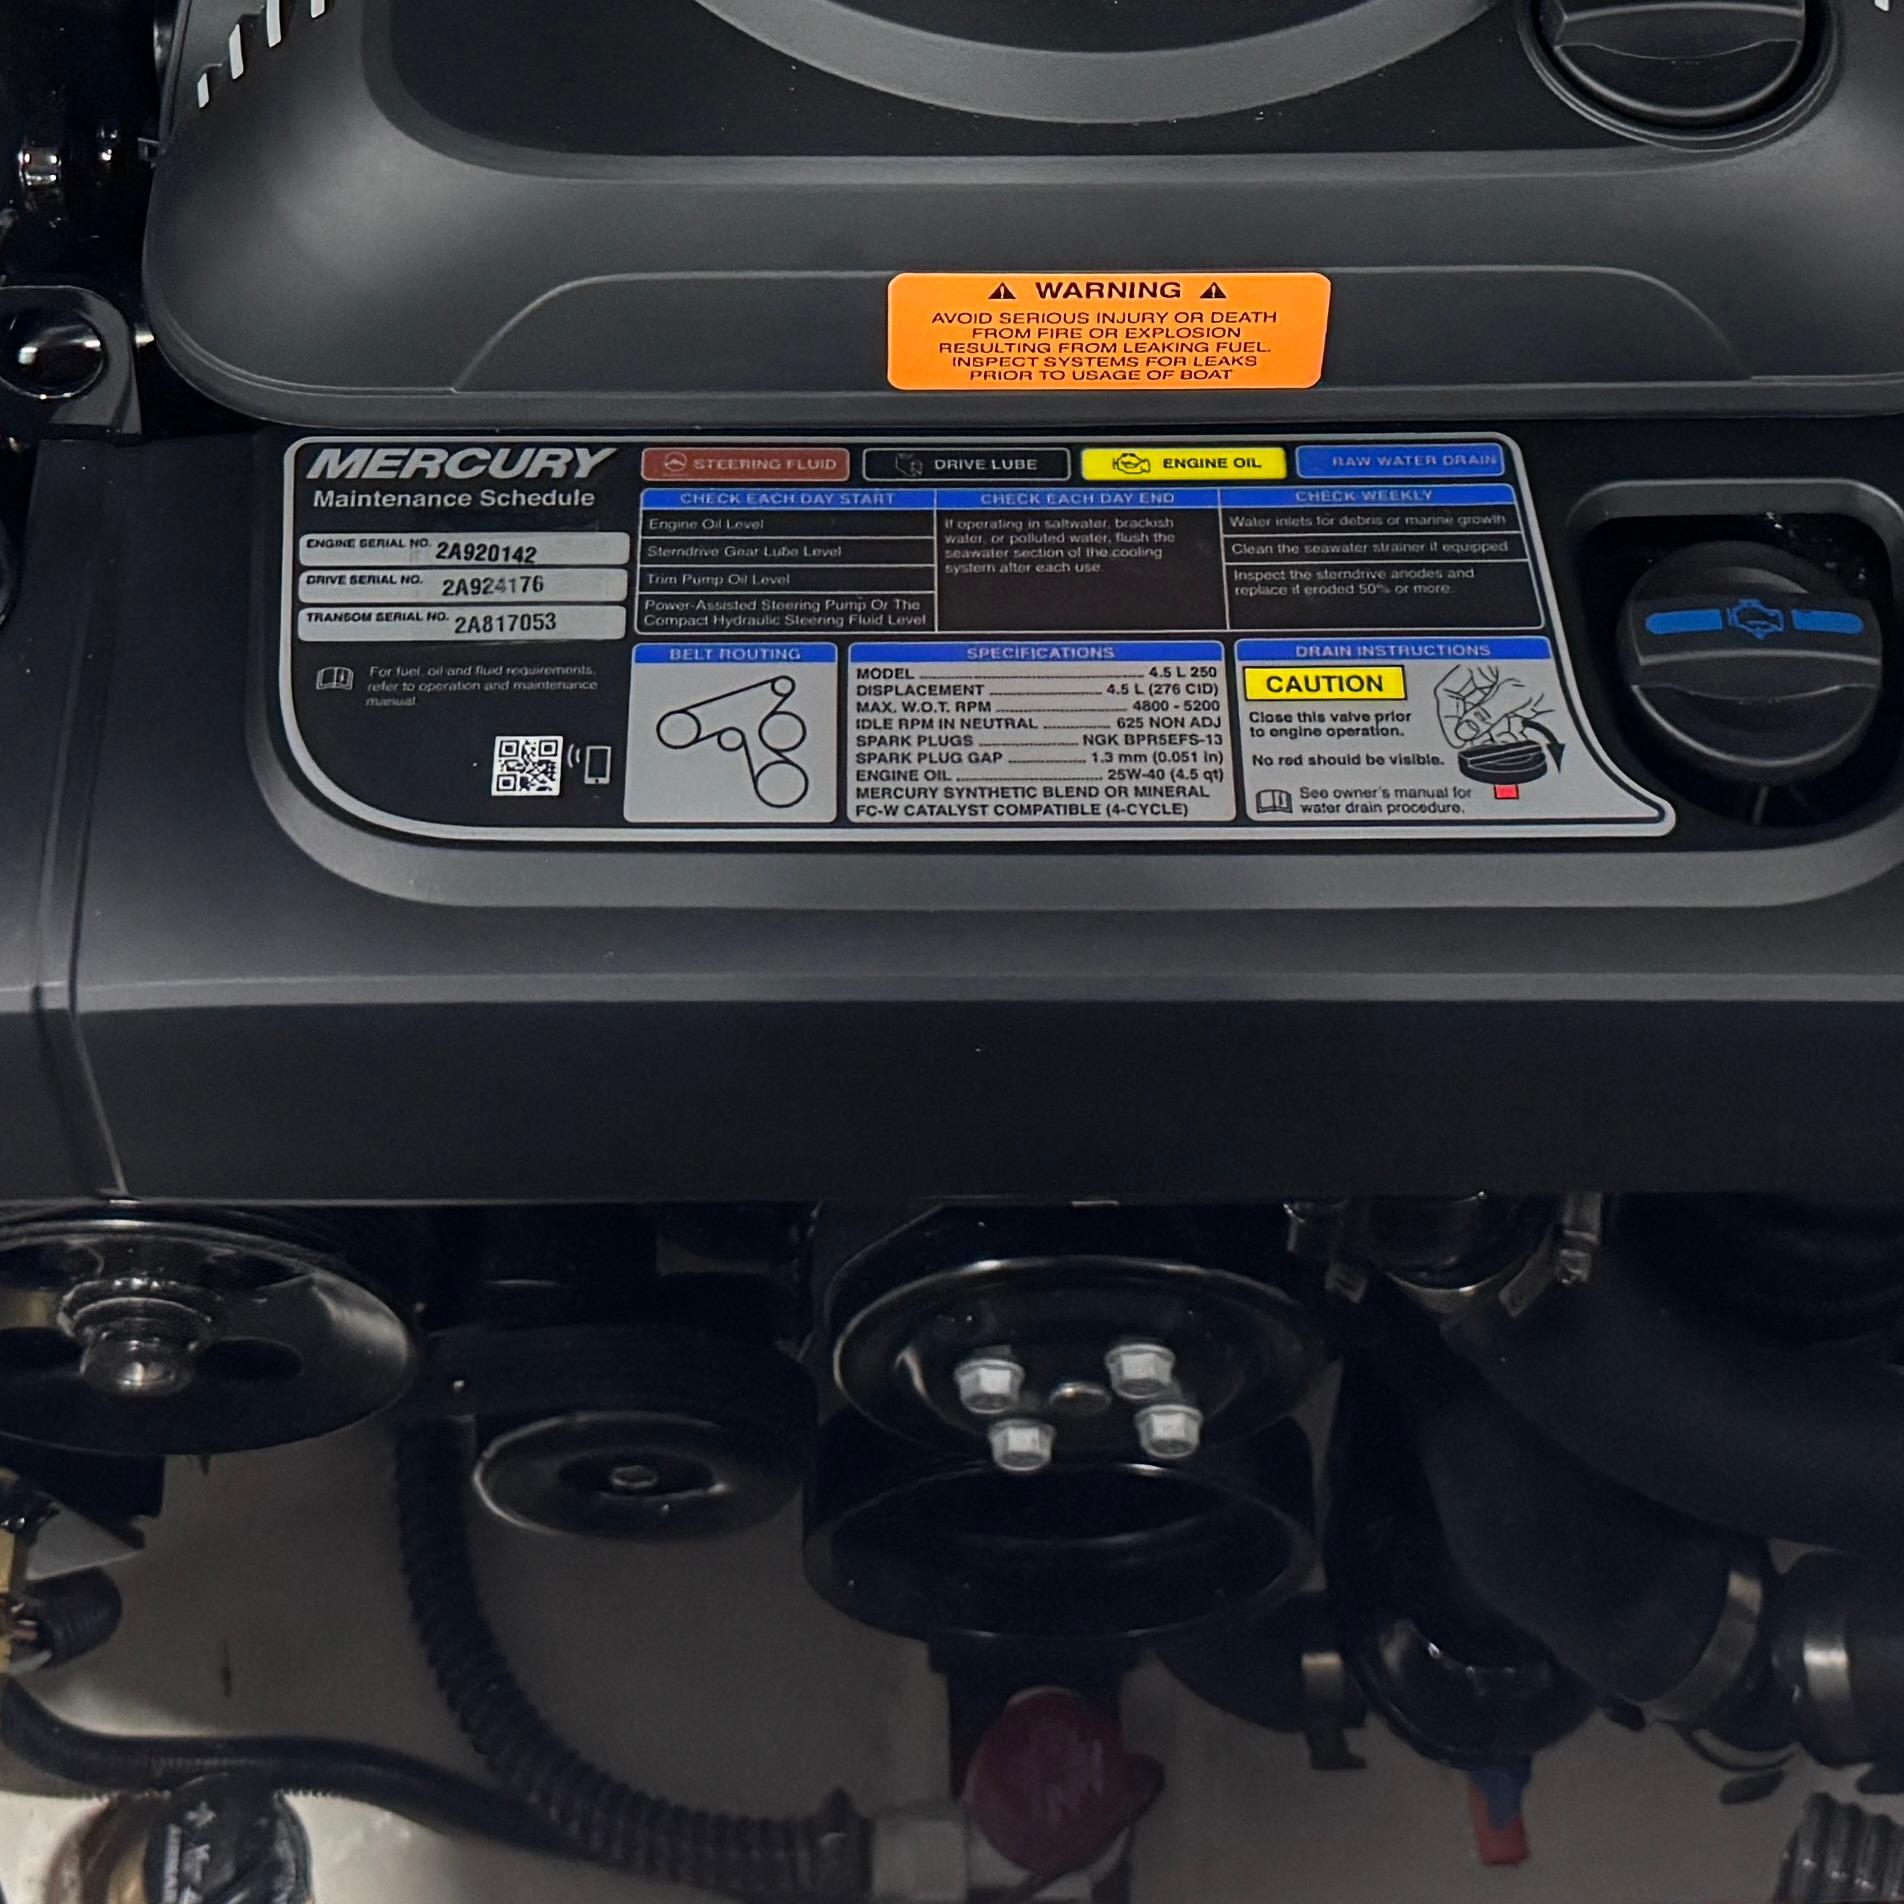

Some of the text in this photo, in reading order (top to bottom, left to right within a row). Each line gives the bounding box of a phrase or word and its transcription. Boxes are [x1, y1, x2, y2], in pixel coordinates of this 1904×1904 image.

[1035, 282, 1181, 299] WARNING
[932, 311, 1276, 325] AVOID SERIOUS INJURY OR DEATH
[972, 327, 1241, 339] FROM FIRE OR EXPLOSION
[939, 342, 1050, 354] RESULTING
[1058, 342, 1116, 353] FROM
[1123, 342, 1209, 353] LEAKING
[953, 355, 1257, 367] INSPECT SYSTEMS FOR LEAKS
[970, 369, 1233, 381] PRIOR TO USAGE OF BOAT
[306, 448, 617, 479] MERCURY
[694, 459, 837, 470] STEERING FLUID
[935, 459, 1037, 470] DRIVE LUBE
[1163, 457, 1261, 469] ENGINE OIL
[1333, 455, 1497, 466] RAW WATER DRAIN
[313, 489, 595, 508] Maintenance Schedule
[680, 493, 894, 504] CHECK EACH DAY START
[981, 493, 1174, 505] CHECK EACH DAY END
[1296, 490, 1432, 501] CHECK WEEKLY
[649, 519, 764, 531] Engine Oil Level
[307, 539, 355, 547] ENGINE
[360, 539, 405, 547] SERIAL
[436, 542, 536, 563] 2A920142
[307, 576, 346, 585] DRIVE
[350, 575, 397, 585] SERIAL
[442, 575, 544, 596] 2A924176
[308, 613, 372, 622] TRANSOM
[376, 612, 423, 621] SERIAL
[455, 613, 556, 634] 2A817053
[670, 648, 800, 660] BELT ROUTING
[967, 648, 1115, 659] SPECIFICATIONS
[1296, 645, 1491, 657] DRAIN INSTRUCTIONS
[856, 666, 1217, 680] MODEL 4.5 L 250
[856, 683, 1219, 696] DISPLACEMENT 4.5 L (276 CID)
[1266, 676, 1384, 692] CAUTION
[856, 701, 897, 713] MAX.
[902, 701, 950, 713] W.O.T.
[955, 701, 992, 713] RPM
[1132, 700, 1169, 713] 4800
[1184, 700, 1220, 712] 5200
[856, 716, 1221, 730] IDLE RPM IN NEUTRAL 625 NON ADJ
[1249, 711, 1412, 726] Close this valve prior
[1250, 726, 1404, 739] to engine operation.
[856, 733, 1222, 747] SPARK PLUGS NGK BPR5EFS-13
[856, 751, 1224, 764] SPARK PLUG GAP 1.3 mm (0.051 in)
[1252, 753, 1445, 766] No red should be visible.
[856, 768, 1224, 782] ENGINE OIL 25W-40 (4.5 qt)
[856, 785, 1210, 798] MERCURY SYNTHETIC BLEND OR MINERAL
[1300, 786, 1472, 800] See owner's manual for
[856, 802, 1188, 817] FC-W CATALYST COMPATIBLE (4-CYCLE)
[1300, 802, 1465, 816] water drain procedure.
